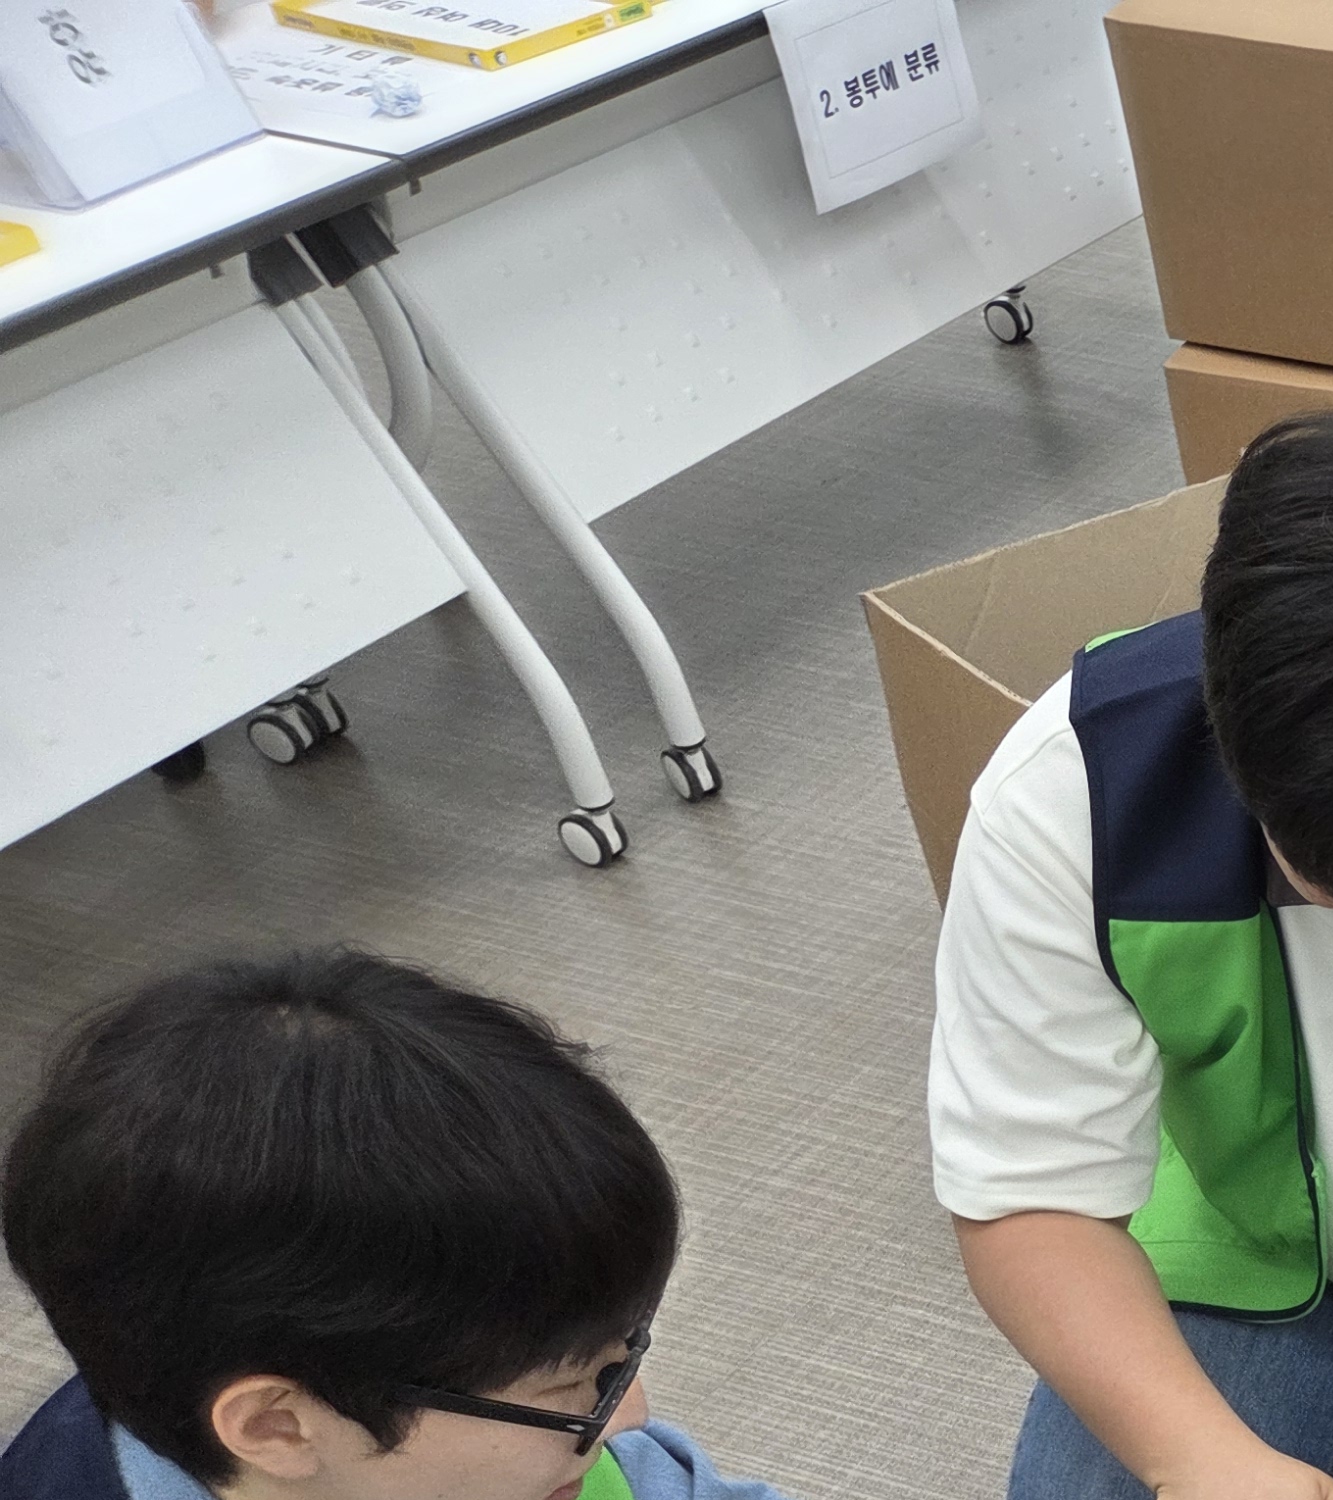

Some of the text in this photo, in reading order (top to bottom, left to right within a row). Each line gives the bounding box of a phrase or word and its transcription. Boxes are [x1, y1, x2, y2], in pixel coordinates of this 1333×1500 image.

[820, 43, 941, 118] 2. 봉투에 분류
